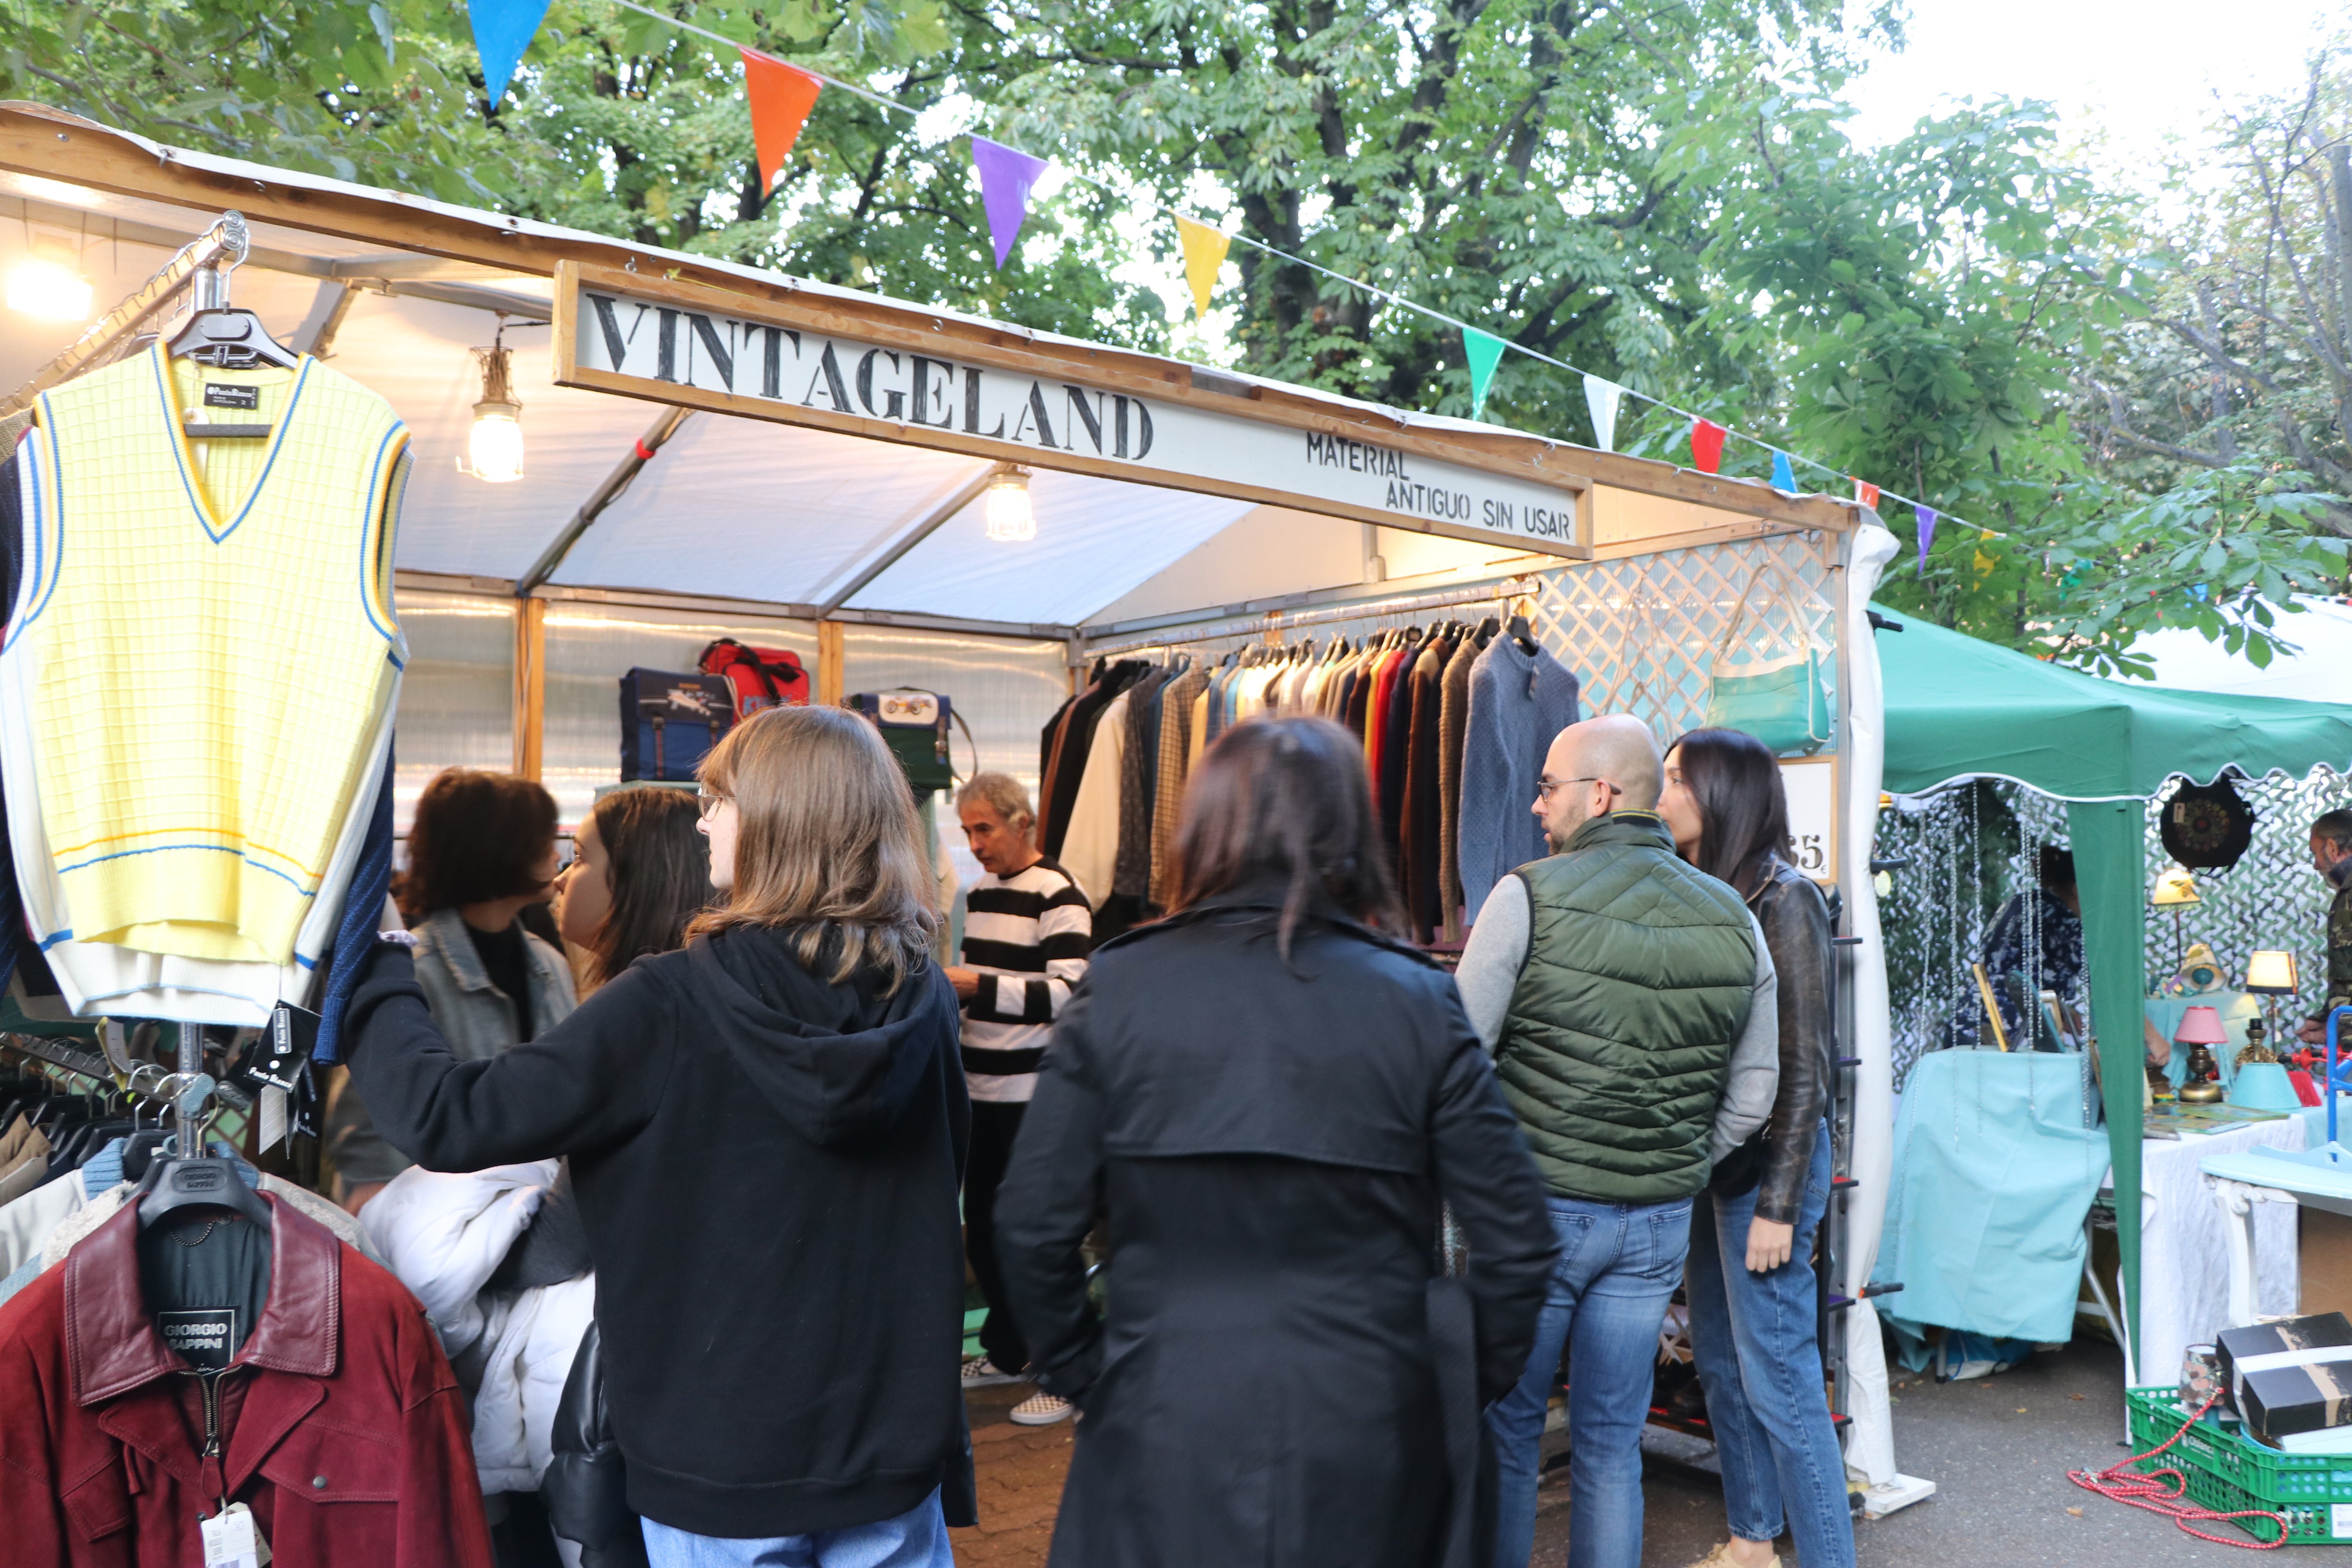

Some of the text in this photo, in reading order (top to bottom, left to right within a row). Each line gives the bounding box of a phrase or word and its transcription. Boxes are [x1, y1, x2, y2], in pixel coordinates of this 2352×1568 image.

[586, 293, 1154, 461] VINTAGELAND
[1307, 431, 1410, 481] MATERIAL
[1386, 481, 1570, 539] ANTIGUO SIN USAR
[163, 1323, 228, 1336] GIORGIO
[169, 1337, 223, 1350] SAPPINI
